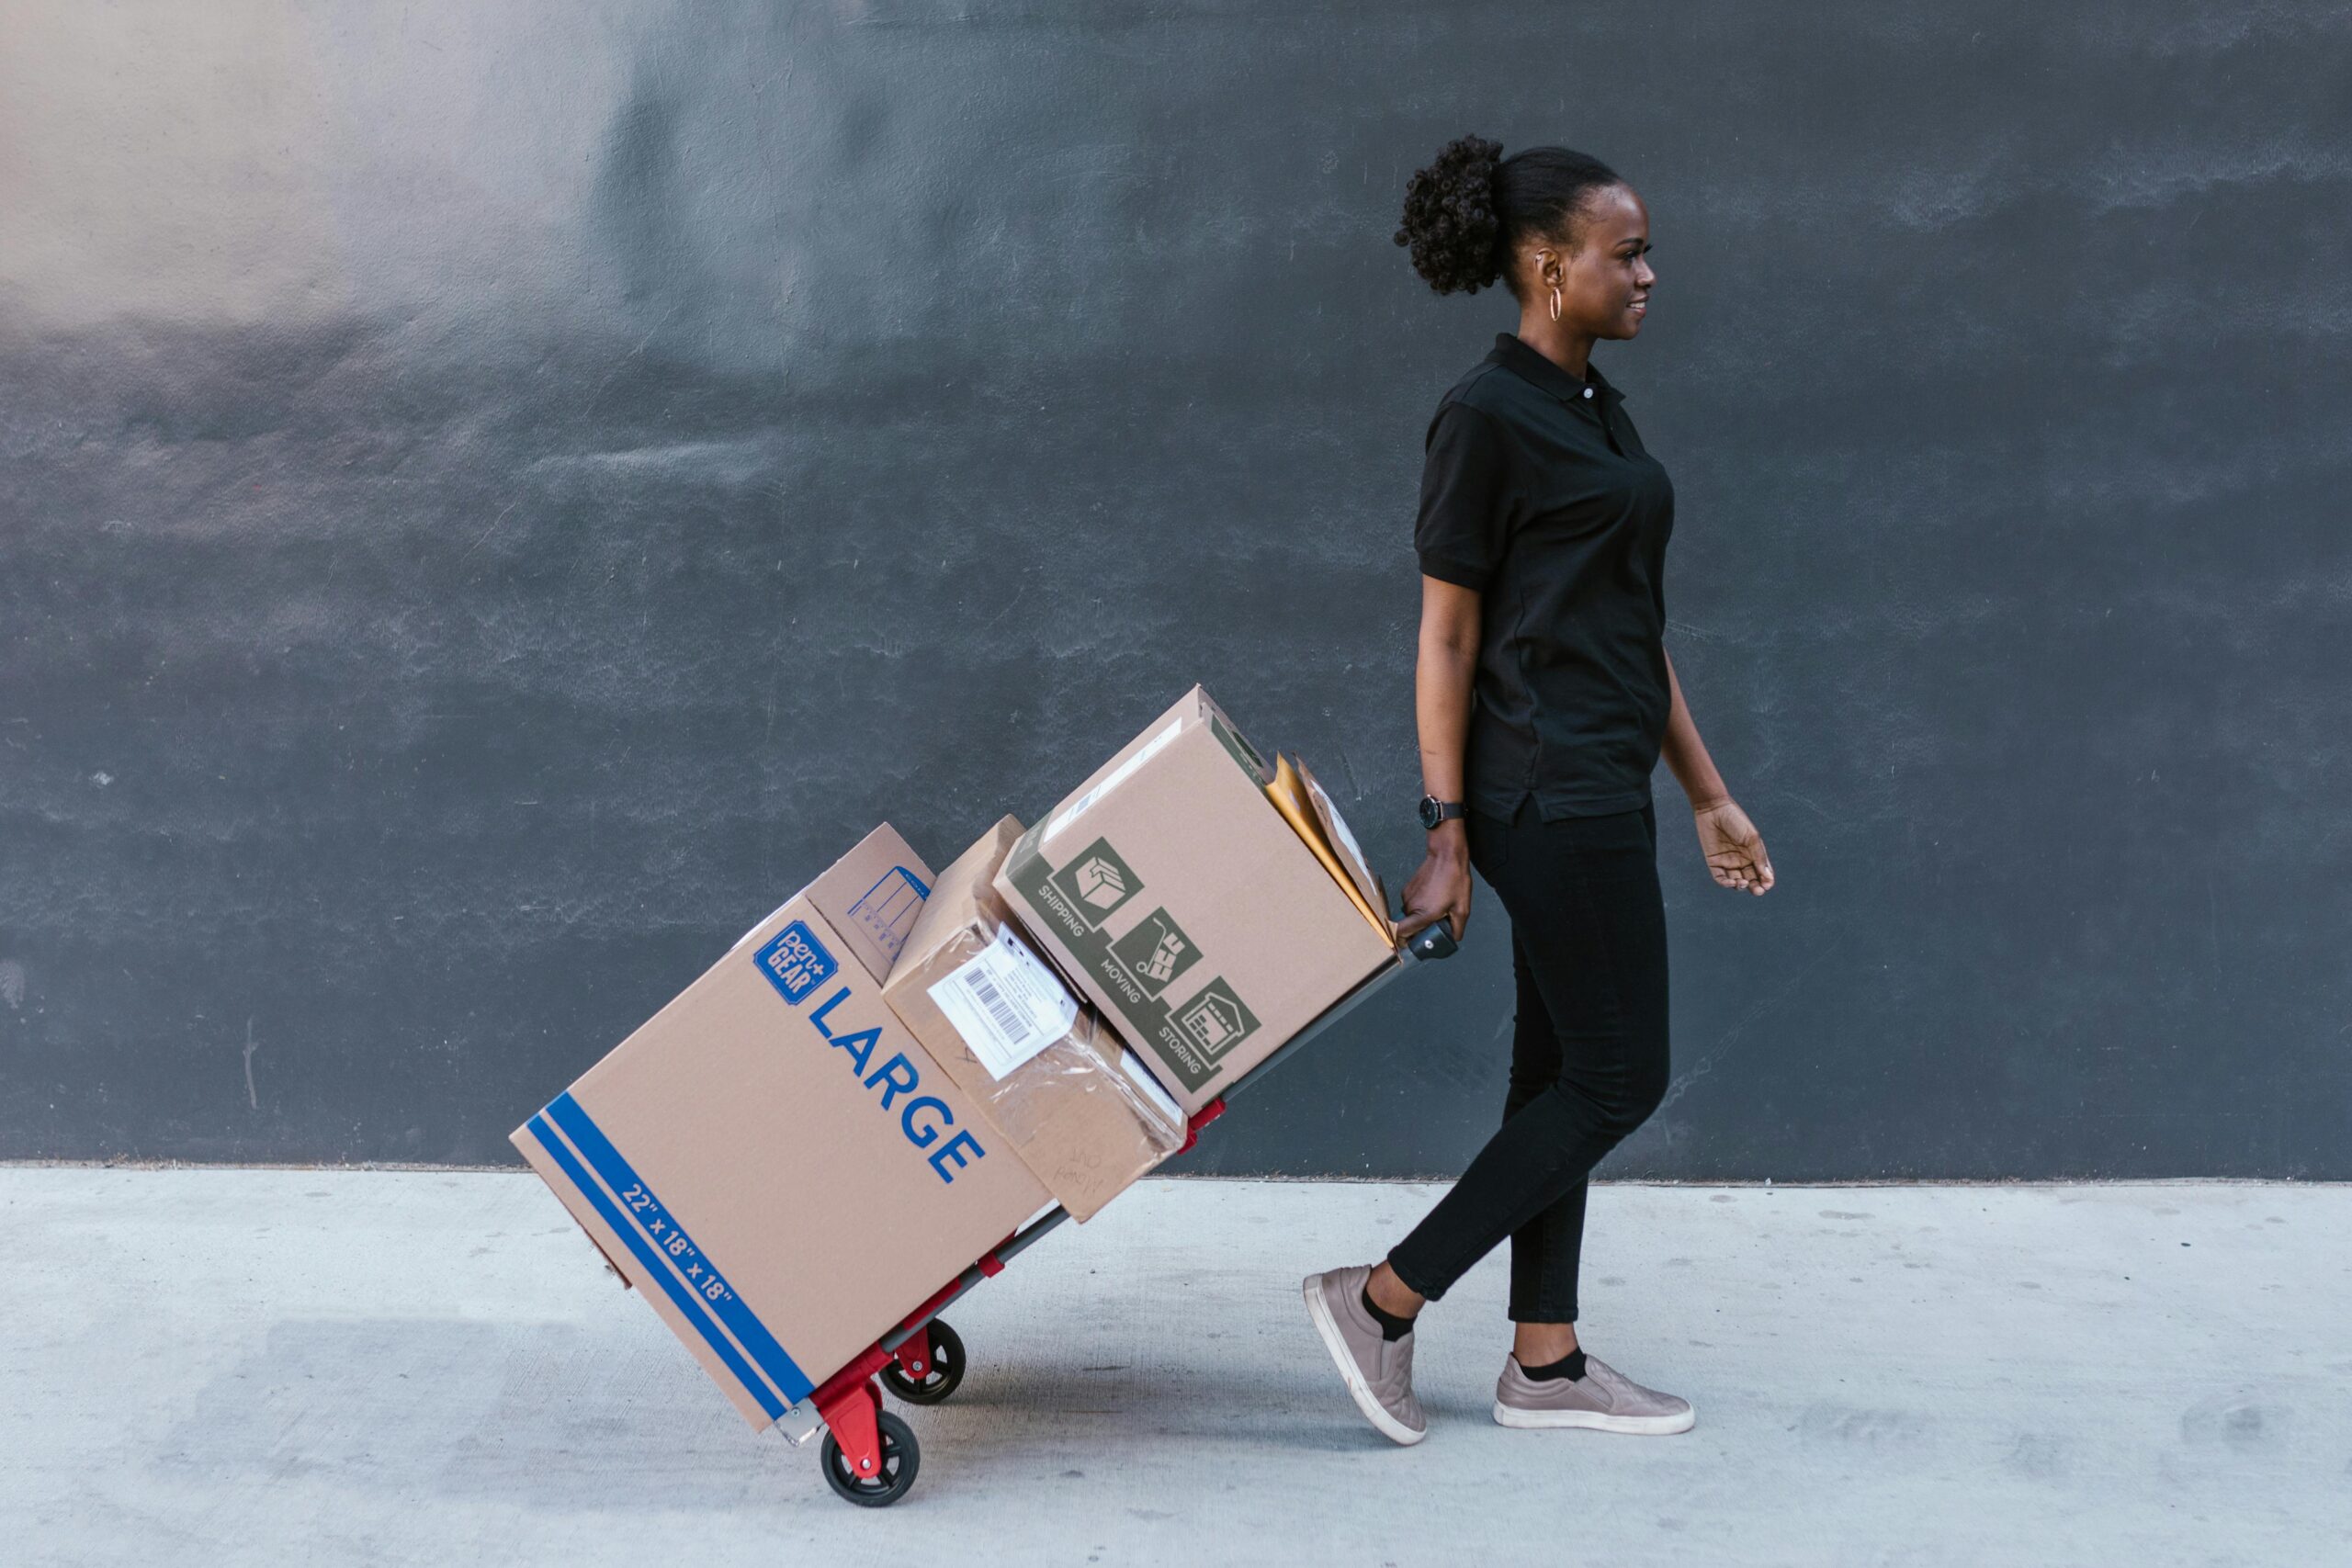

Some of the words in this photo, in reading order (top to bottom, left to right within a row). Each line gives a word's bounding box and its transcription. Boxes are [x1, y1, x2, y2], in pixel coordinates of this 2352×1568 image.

[1038, 885, 1084, 937] SHIPPING
[768, 946, 811, 994] GEAR
[1101, 959, 1141, 1004] MOVING
[1159, 1026, 1202, 1075] STORING
[808, 986, 986, 1184] LARGE
[622, 1183, 658, 1213] 22"
[650, 1218, 666, 1235] x
[663, 1230, 695, 1257] 18"
[686, 1262, 703, 1280] x
[701, 1274, 732, 1301] 18"
